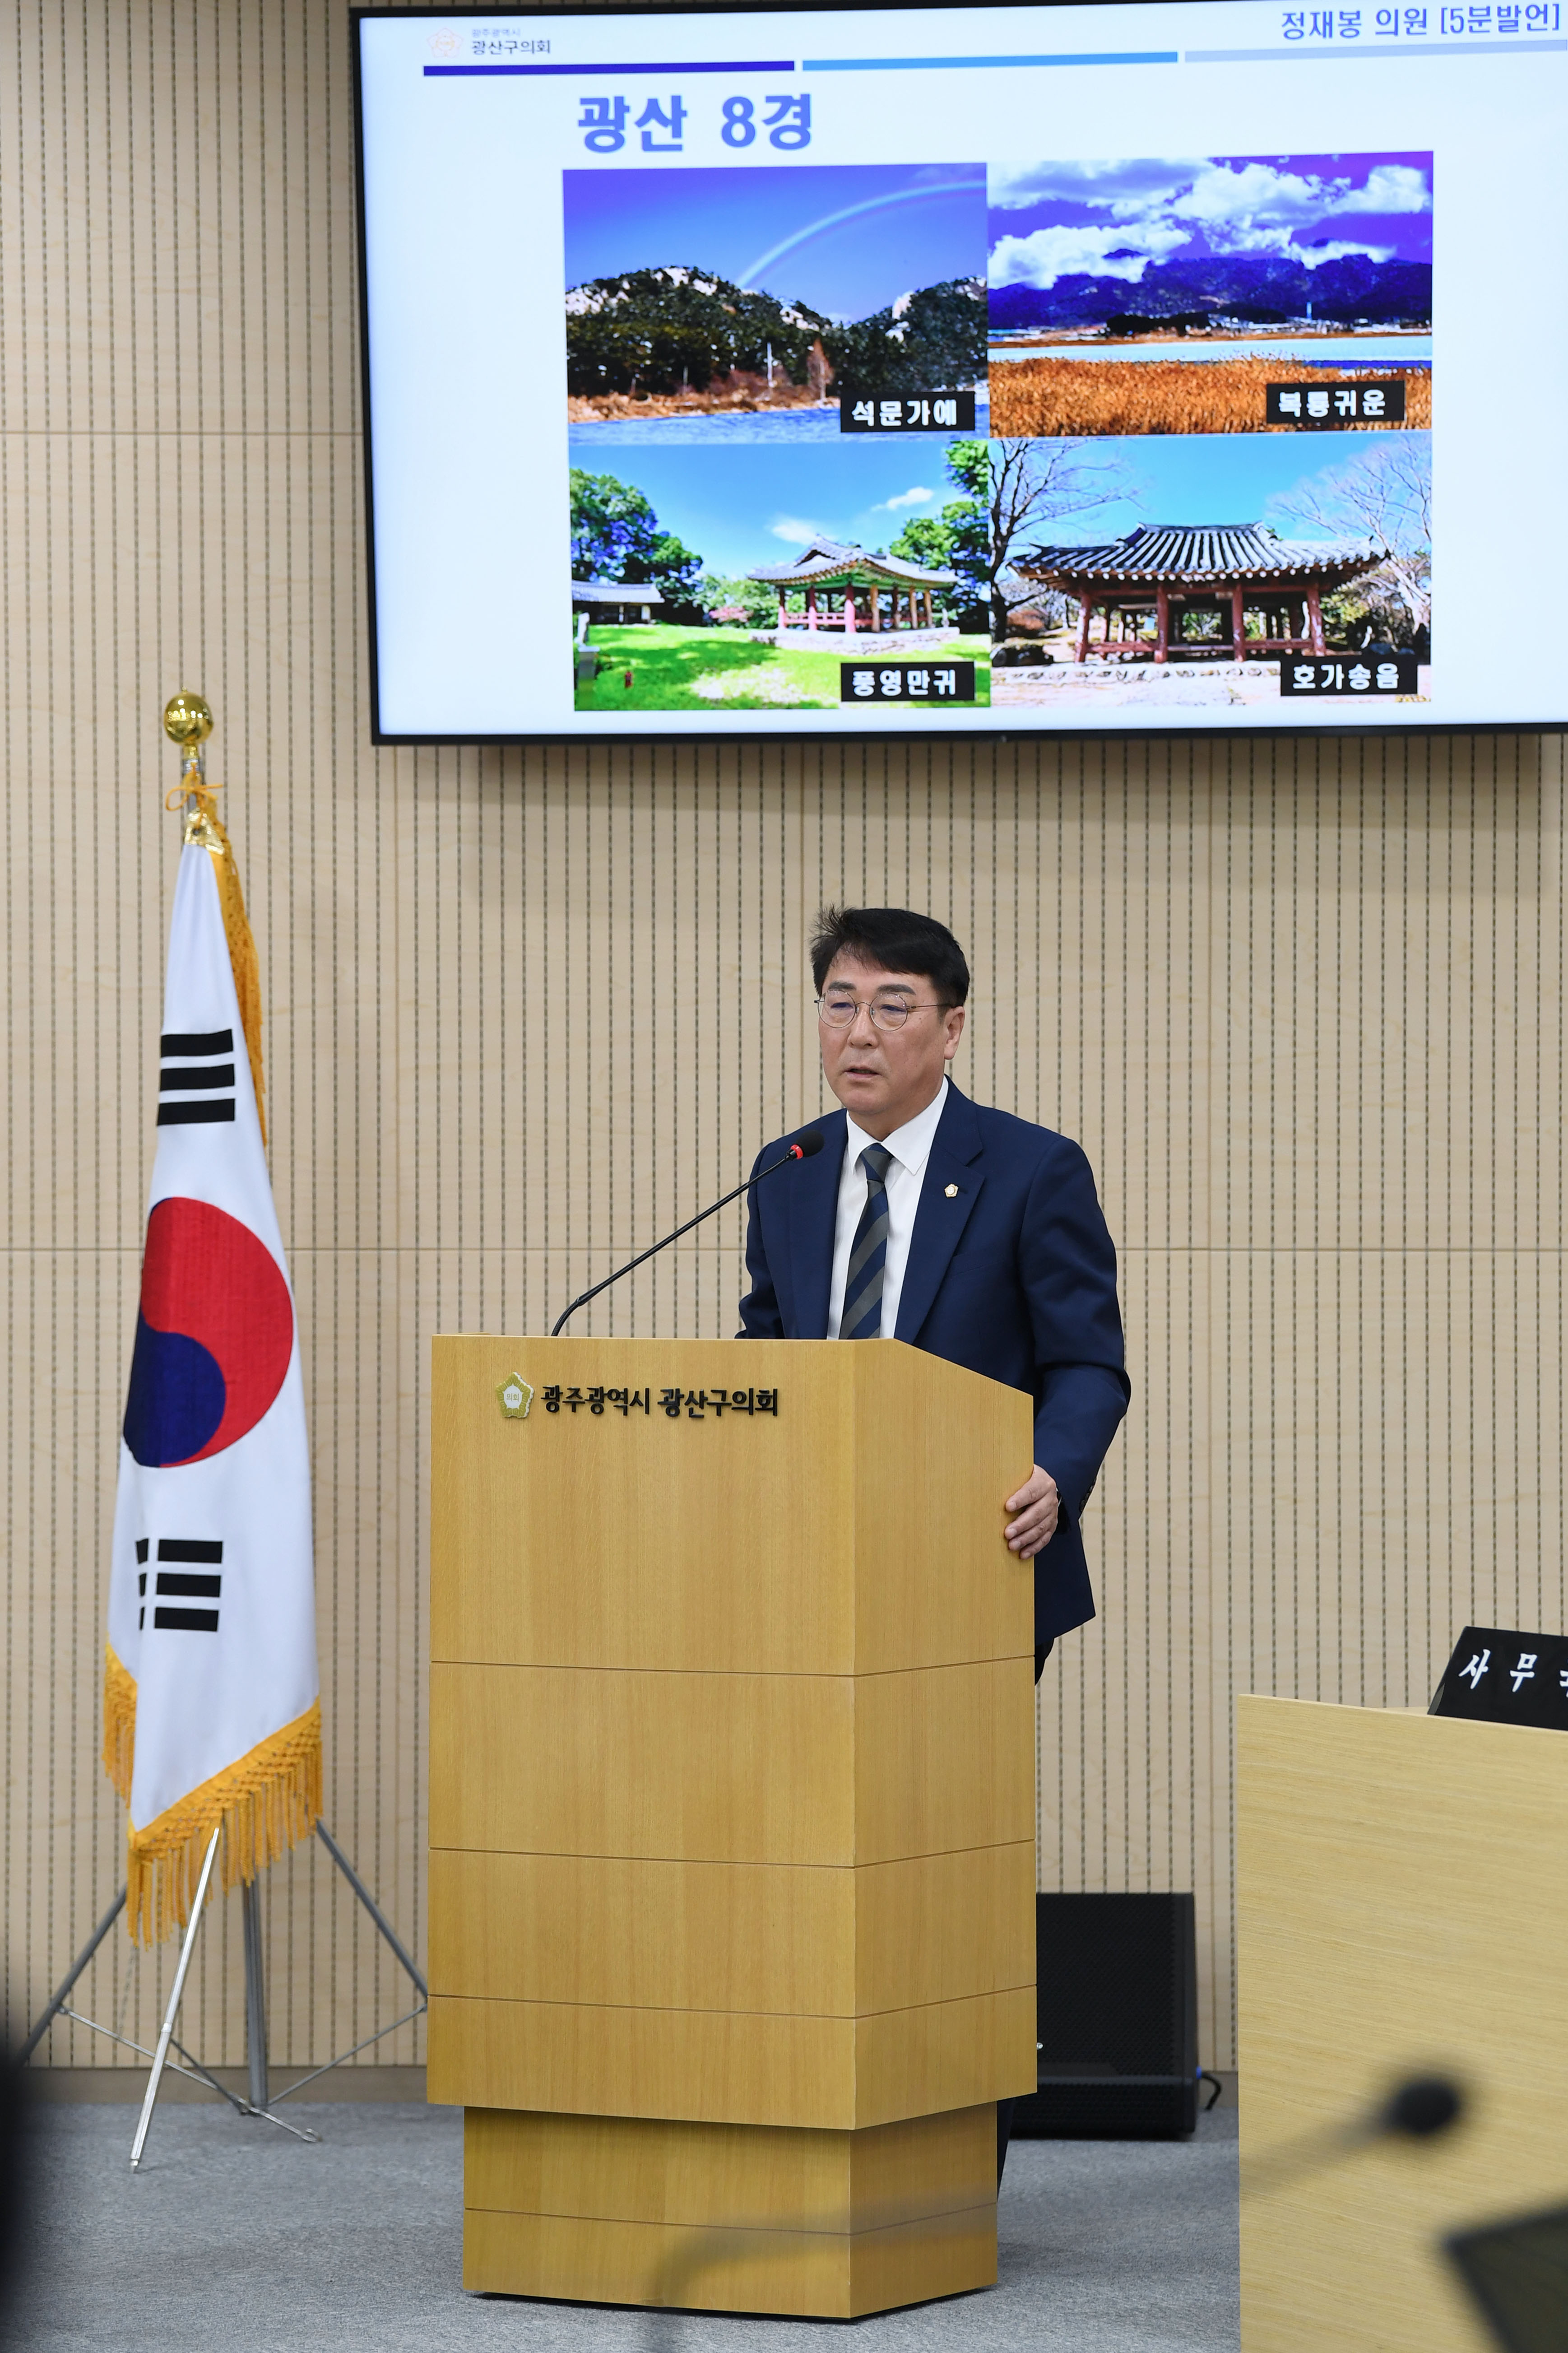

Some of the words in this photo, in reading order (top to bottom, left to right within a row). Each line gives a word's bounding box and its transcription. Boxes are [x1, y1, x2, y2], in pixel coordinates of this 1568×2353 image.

[1281, 10, 1362, 40] 정재봉
[1375, 8, 1427, 37] 의원
[1441, 3, 1559, 34] [5분발언]
[472, 40, 550, 55] 광산구의회
[578, 95, 687, 153] 광산
[721, 93, 811, 150] 8경
[851, 399, 957, 427] 석문가예
[852, 669, 956, 697] 풍영만귀
[1293, 663, 1399, 690] 호가송음
[506, 1393, 519, 1402] 의회
[541, 1385, 649, 1416] 광주광역시
[657, 1388, 778, 1418] 광산구의회
[1458, 1649, 1568, 1697] 사무
